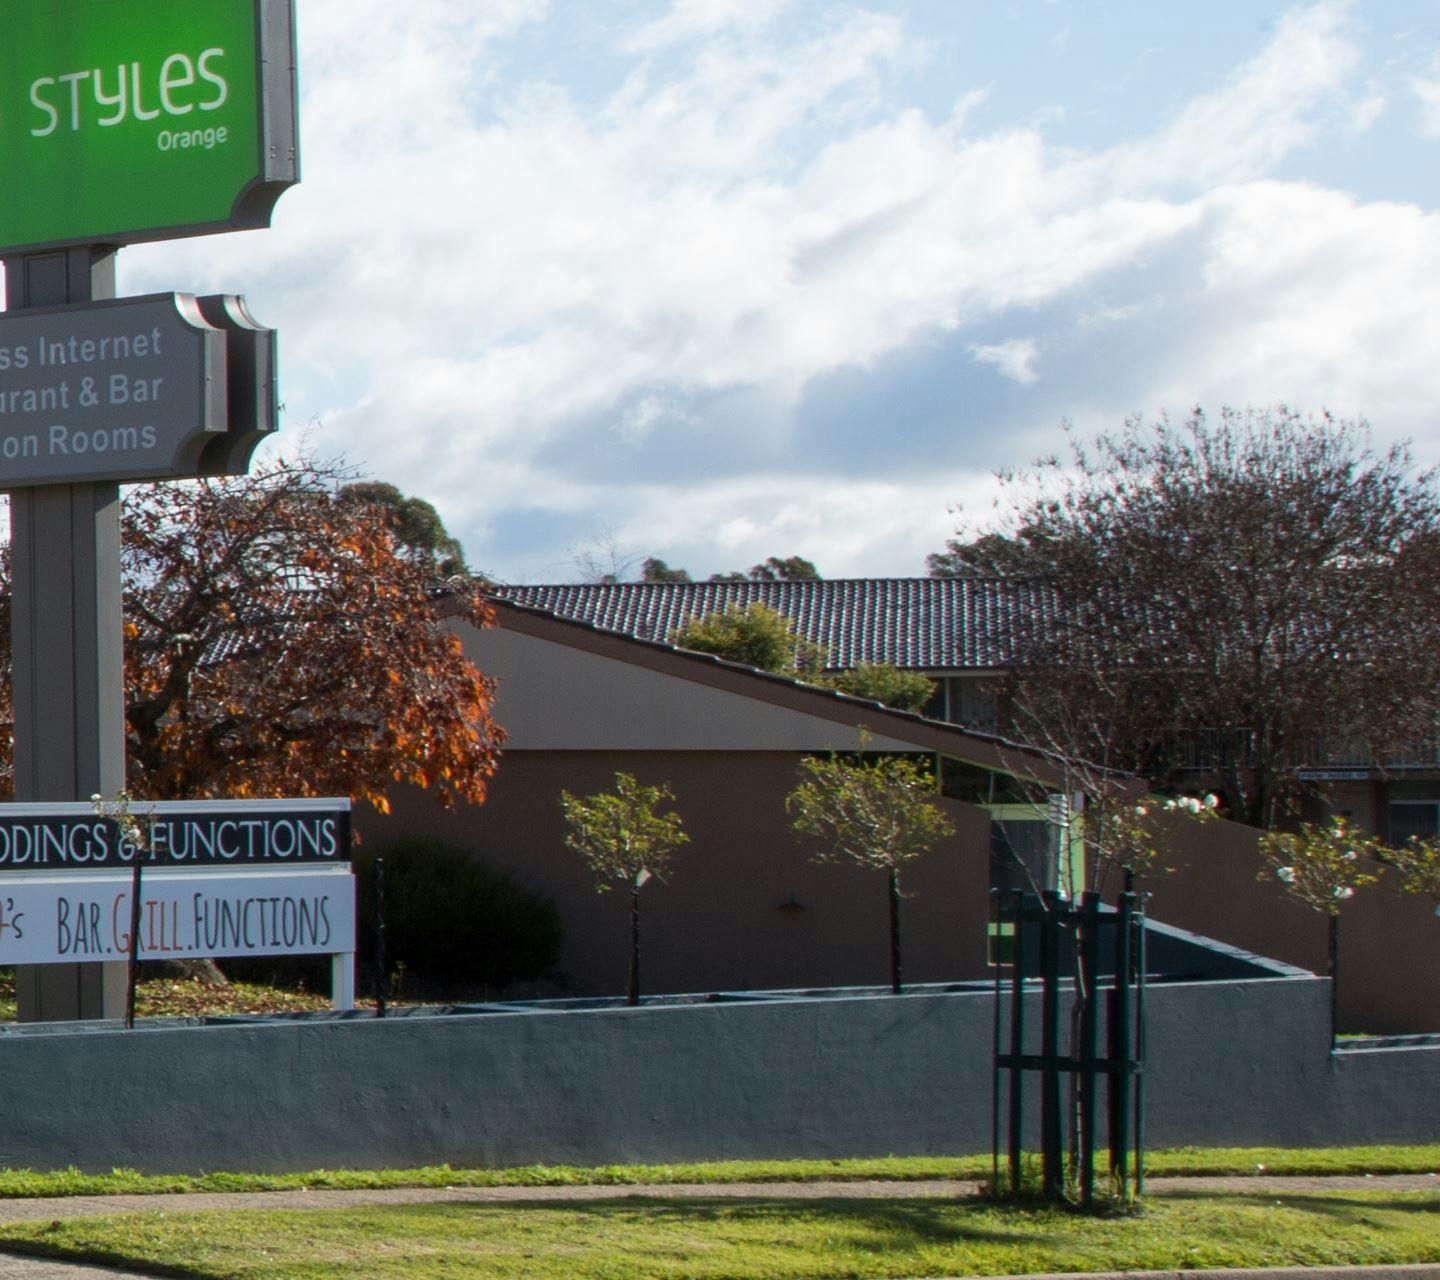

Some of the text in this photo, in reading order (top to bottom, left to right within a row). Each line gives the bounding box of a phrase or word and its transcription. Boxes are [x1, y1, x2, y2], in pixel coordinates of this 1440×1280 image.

[157, 125, 228, 152] Orange
[38, 325, 163, 364] Internet
[78, 376, 100, 406] &
[109, 373, 164, 404] Bar
[48, 419, 157, 454] Rooms
[150, 818, 337, 860] FUNCTIONS
